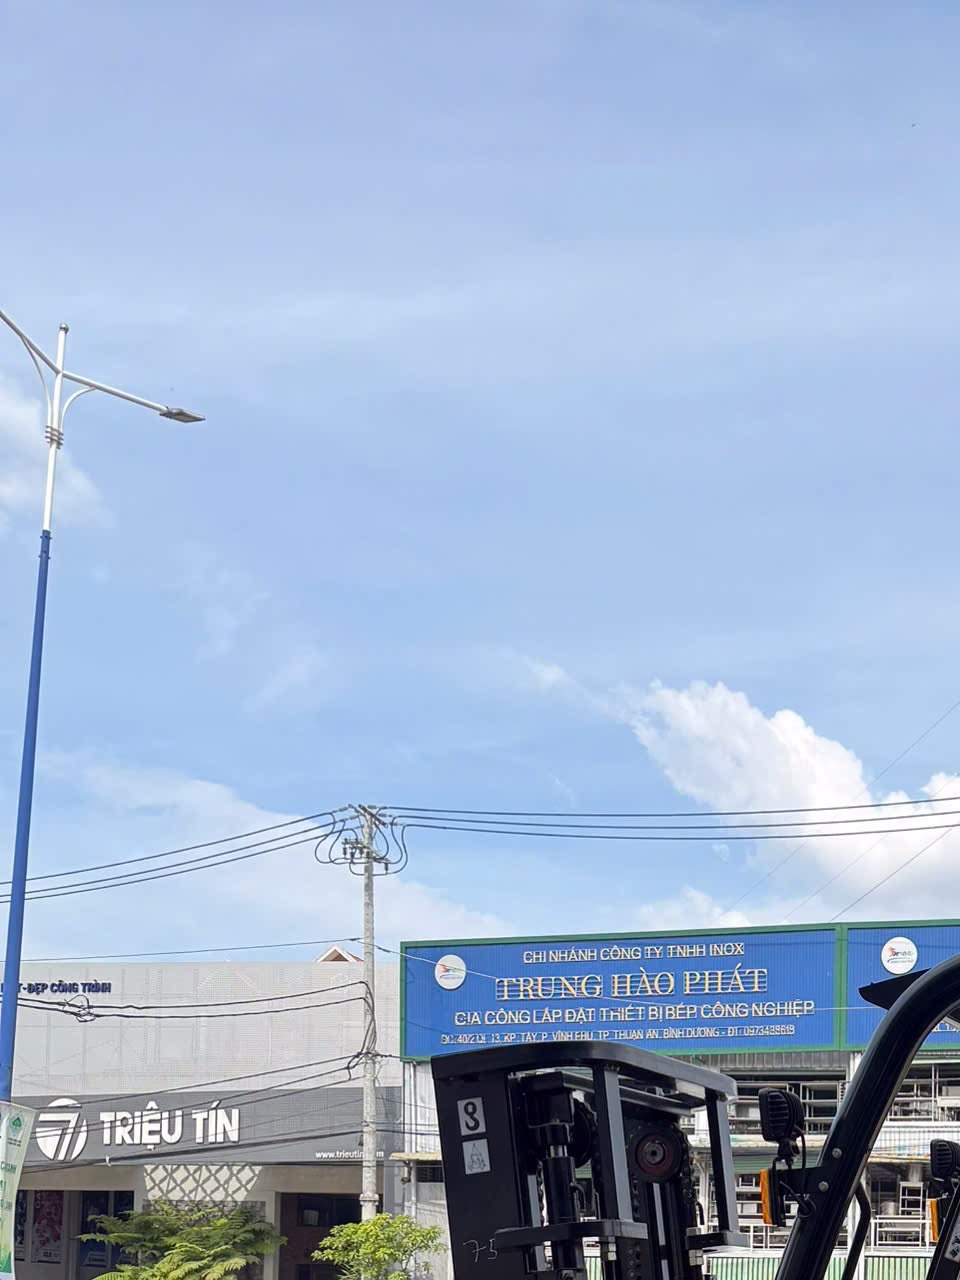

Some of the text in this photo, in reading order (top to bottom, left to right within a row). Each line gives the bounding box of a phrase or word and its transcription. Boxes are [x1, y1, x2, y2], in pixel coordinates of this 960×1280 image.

[524, 943, 744, 963] CHI NHÁNH CÔNG TY TNHH INOX
[495, 963, 768, 1000] TRUNG HÀO PHÁT
[455, 1011, 482, 1026] GIA
[484, 1008, 531, 1025] CÔNG
[648, 1006, 663, 1021] BỊ
[700, 1001, 749, 1018] CÔNG
[751, 999, 815, 1017] NGHIỆP
[663, 1026, 684, 1039] BÌNH
[99, 1100, 239, 1151] TRIỆU TÍN
[315, 1149, 384, 1159] www.trieutinm
